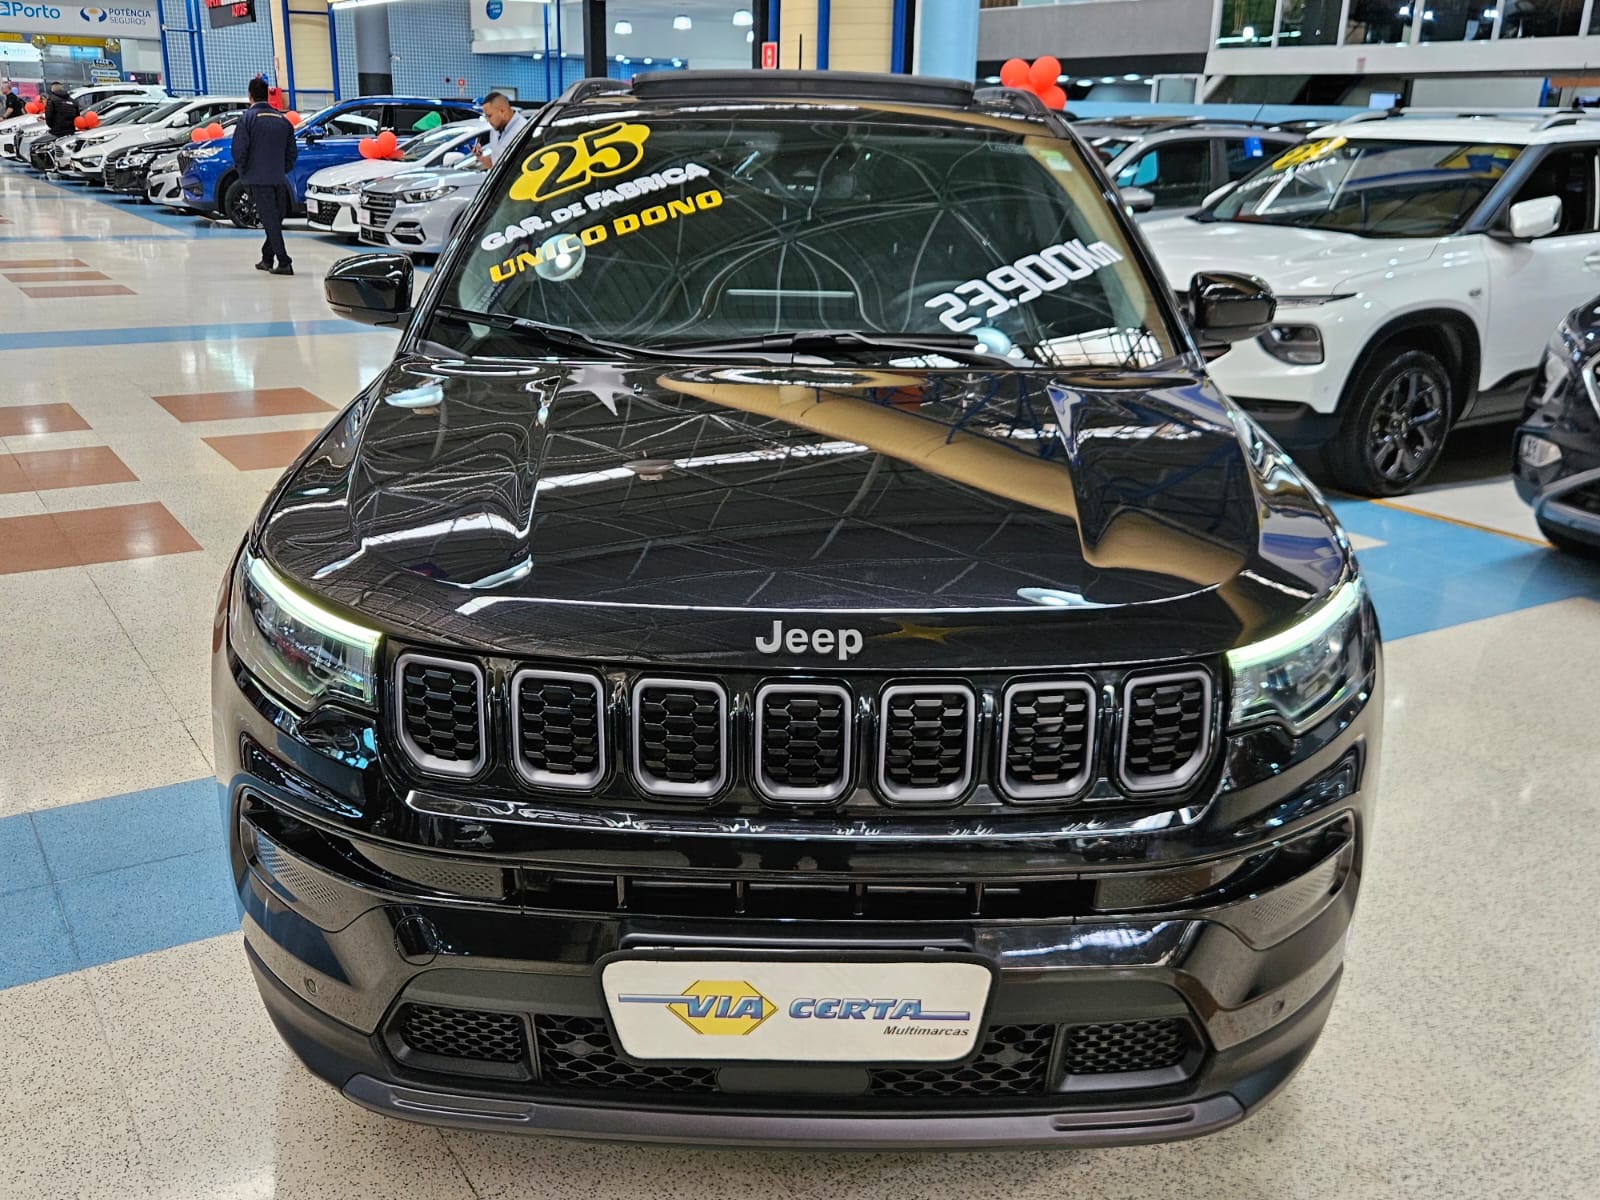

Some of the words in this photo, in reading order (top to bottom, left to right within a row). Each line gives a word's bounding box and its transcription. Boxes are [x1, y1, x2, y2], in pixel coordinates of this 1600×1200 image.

[12, 2, 61, 19] Porto
[108, 7, 151, 18] POTÊNCIA
[109, 16, 146, 25] SEGUROS
[509, 122, 651, 202] 25
[480, 215, 553, 251] GAR.
[551, 203, 587, 225] DE
[489, 224, 608, 283] UNICO
[612, 189, 724, 237] DONO
[755, 620, 863, 661] Jeep
[686, 995, 763, 1020] VIA
[788, 998, 925, 1020] CERTA
[883, 1025, 970, 1038] Multimarcas
